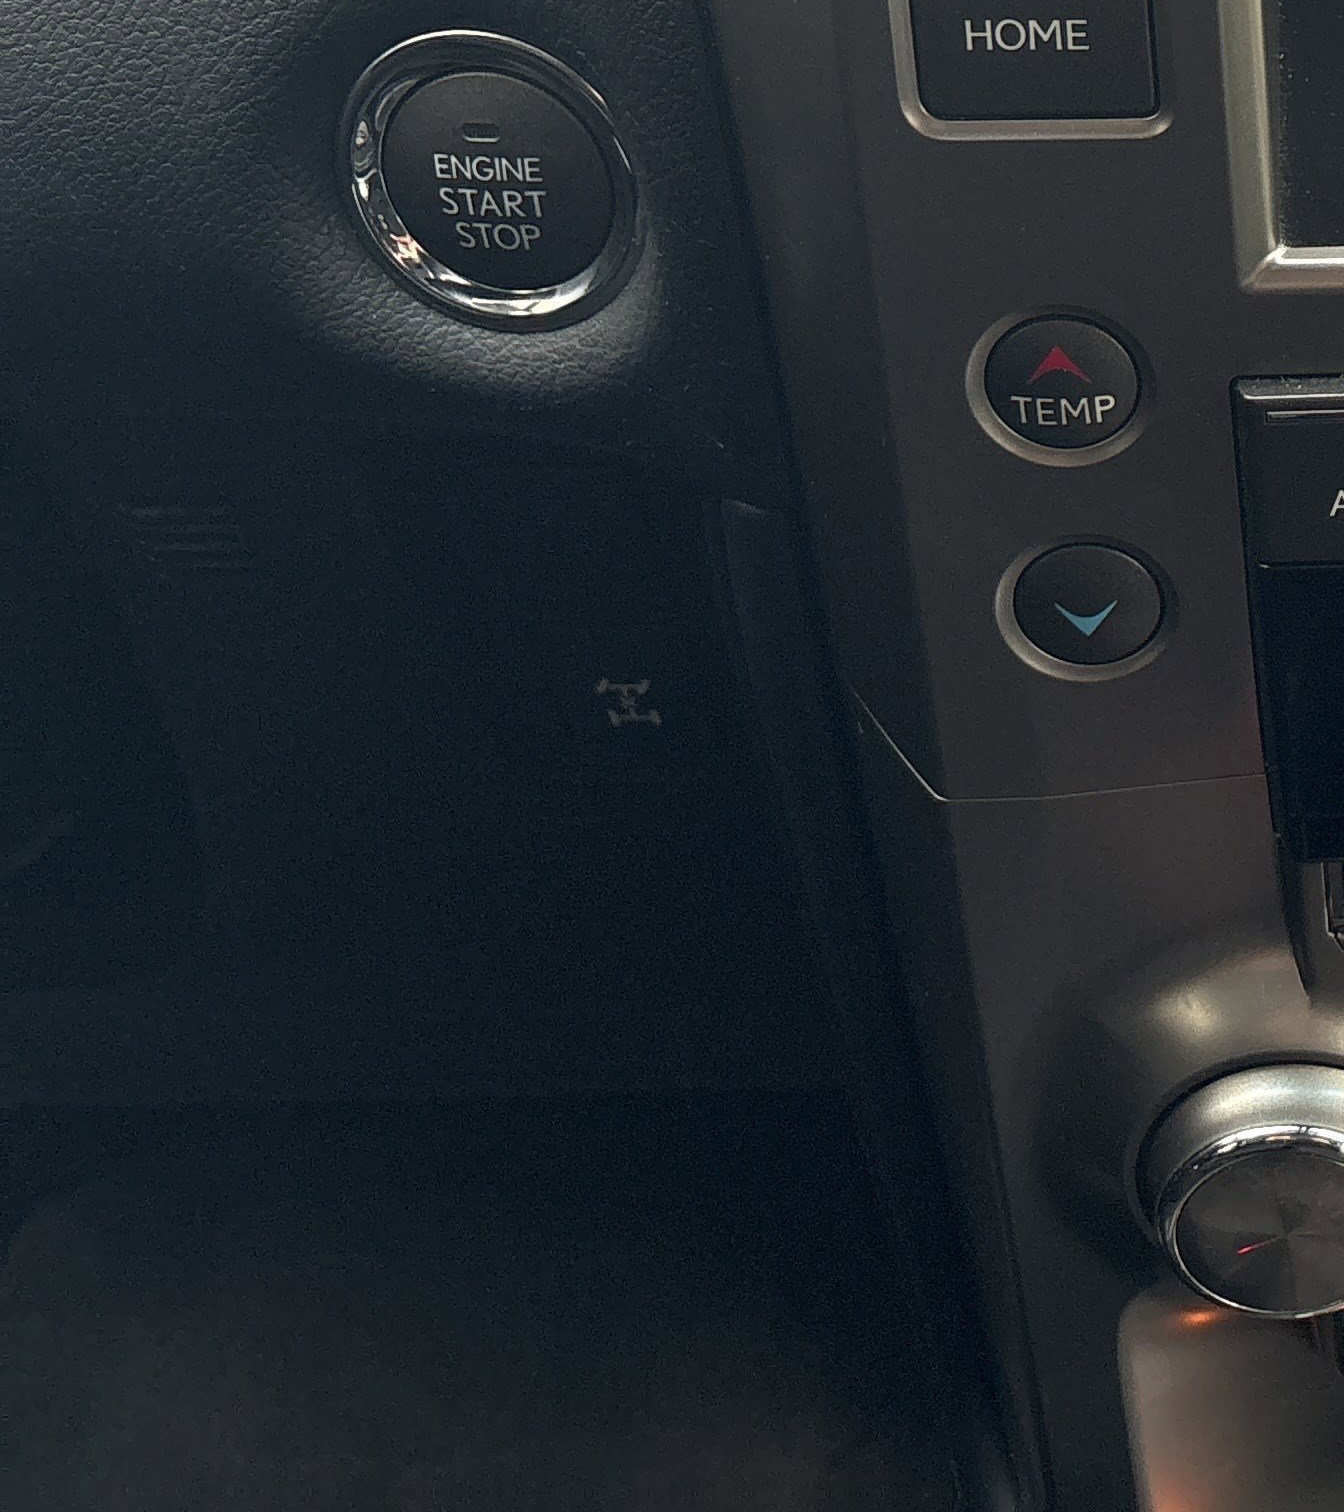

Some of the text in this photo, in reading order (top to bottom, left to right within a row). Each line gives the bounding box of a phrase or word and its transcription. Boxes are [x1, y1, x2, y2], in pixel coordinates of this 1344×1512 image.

[965, 19, 1091, 52] HOME
[433, 153, 544, 184] ENGINE
[439, 189, 547, 220] START
[455, 222, 542, 252] STOP
[1011, 394, 1117, 427] TEMP
